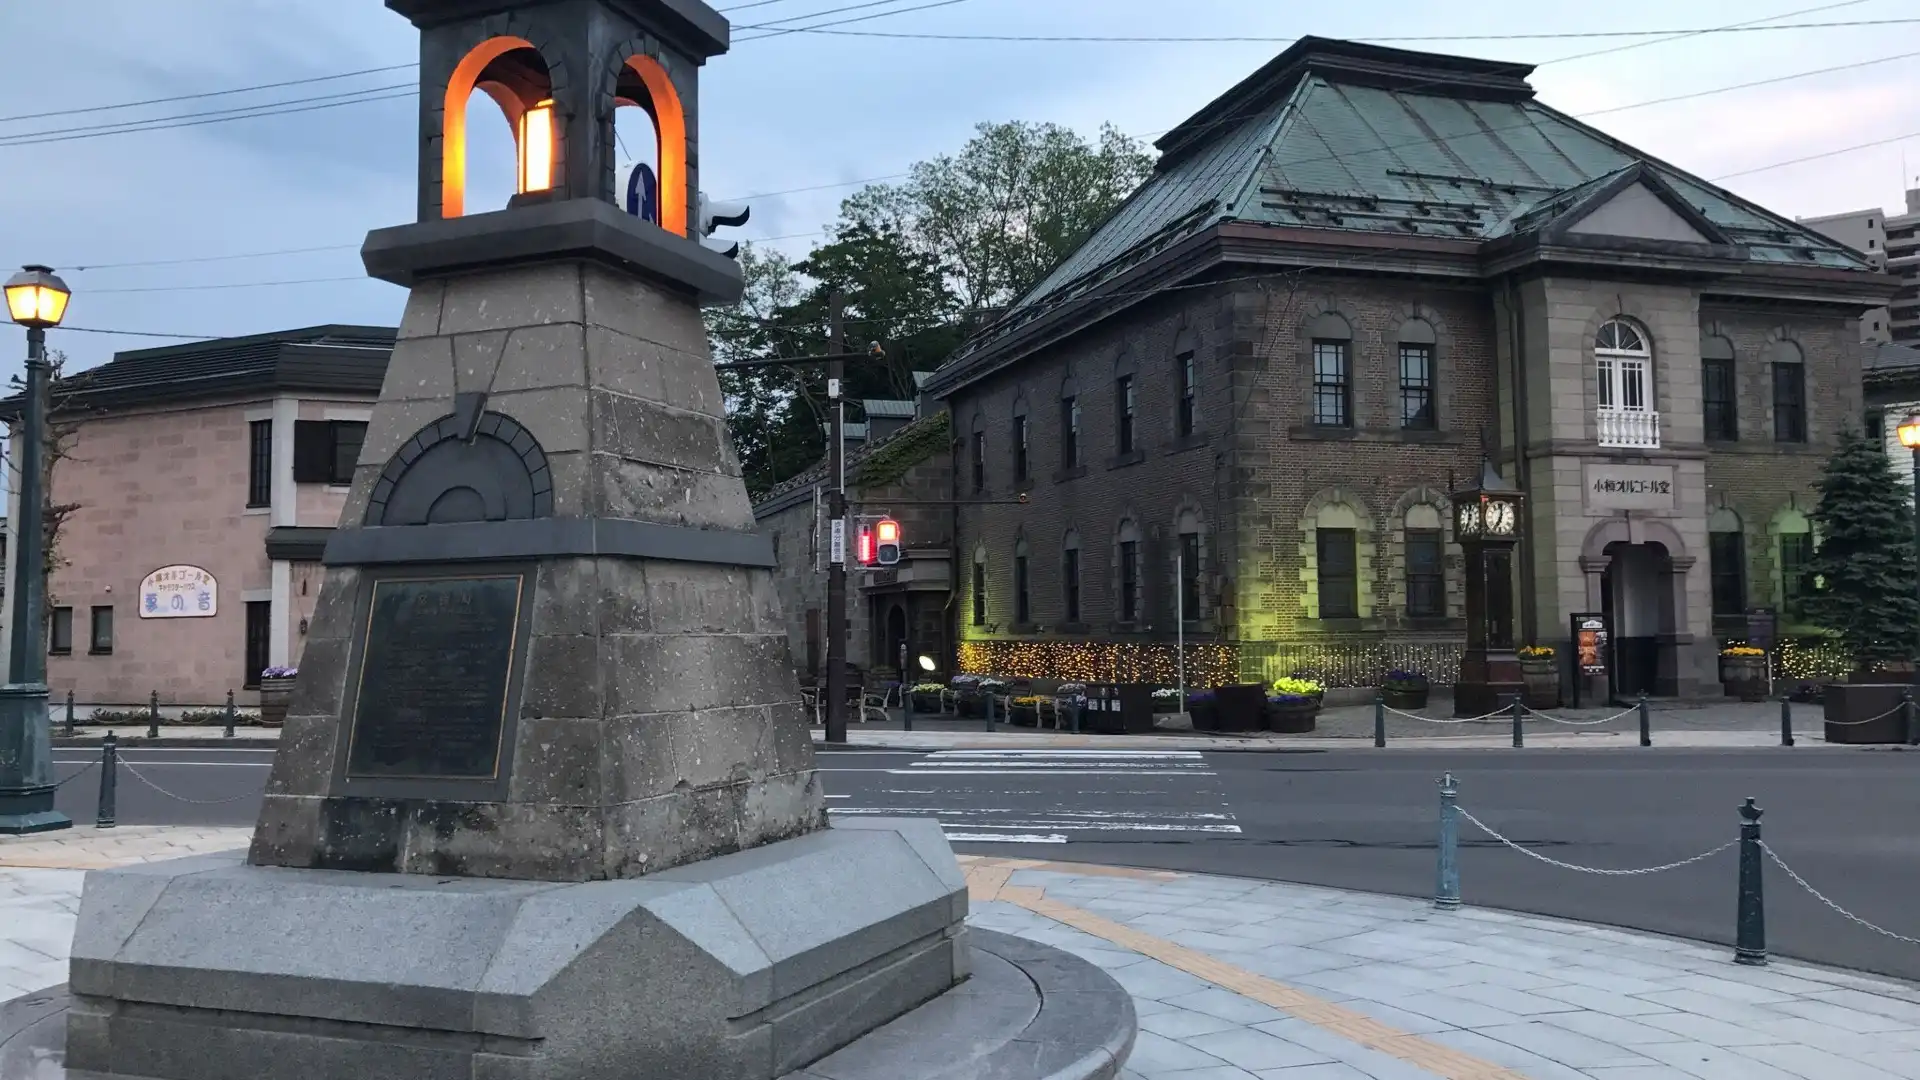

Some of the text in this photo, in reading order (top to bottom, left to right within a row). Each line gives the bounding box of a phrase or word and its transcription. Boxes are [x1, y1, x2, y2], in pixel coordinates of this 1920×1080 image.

[1594, 478, 1671, 494] 小樽オルゴール堂
